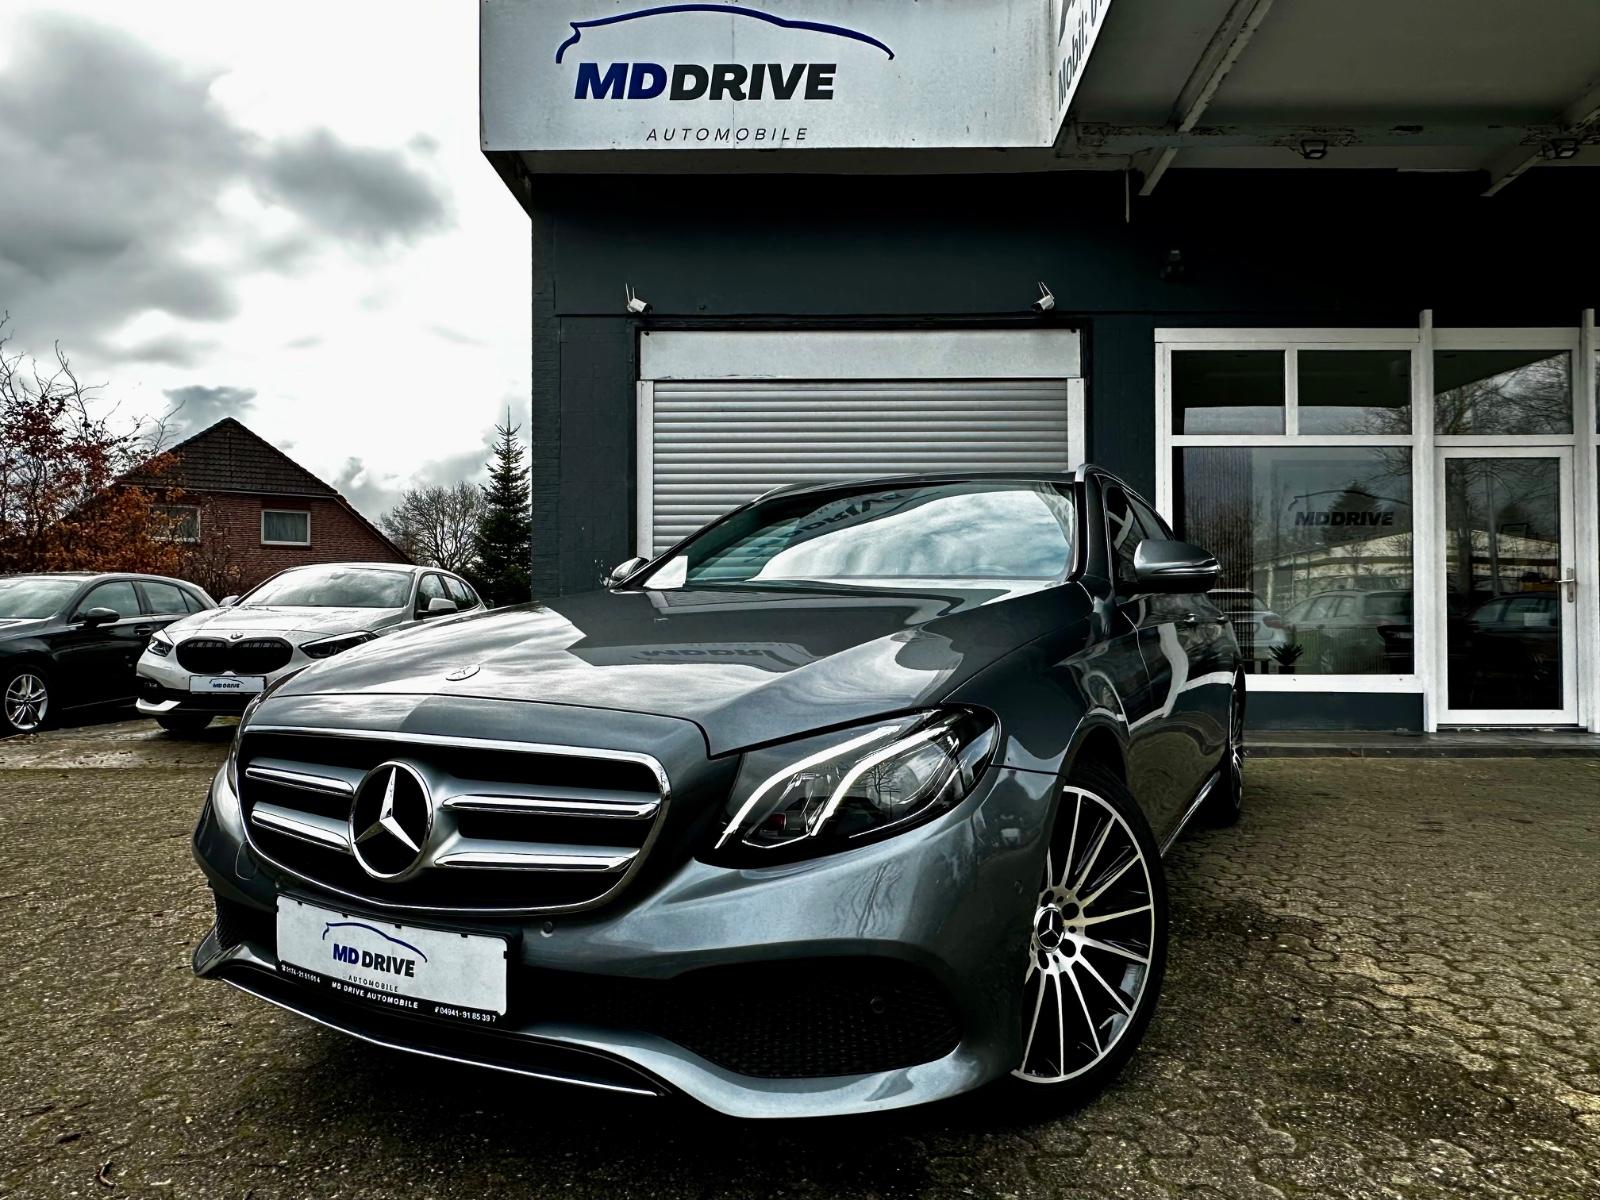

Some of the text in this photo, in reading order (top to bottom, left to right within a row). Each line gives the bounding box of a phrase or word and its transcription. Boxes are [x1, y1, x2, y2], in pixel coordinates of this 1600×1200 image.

[1058, 8, 1088, 111] Mobil:
[646, 127, 808, 141] AUTOMOBILE
[333, 944, 415, 978] MD DRIVE
[348, 975, 399, 992] AUTOMOBILE
[343, 985, 365, 997] DRIVE
[366, 992, 419, 1009] AUTOMOBILE
